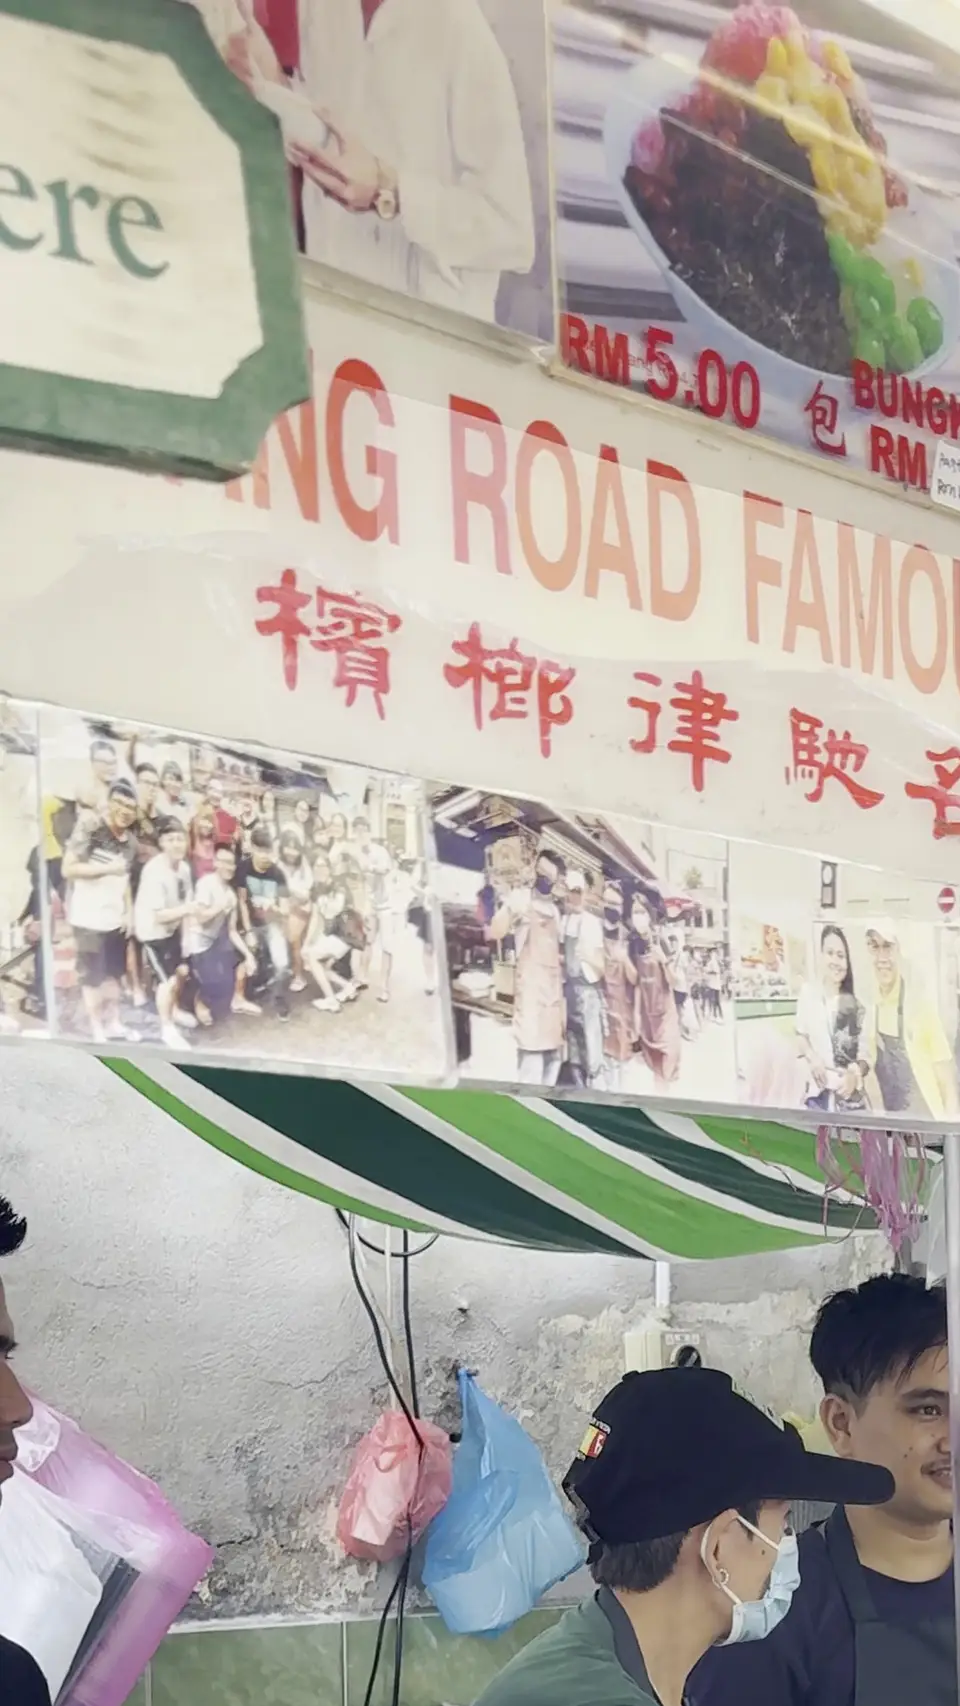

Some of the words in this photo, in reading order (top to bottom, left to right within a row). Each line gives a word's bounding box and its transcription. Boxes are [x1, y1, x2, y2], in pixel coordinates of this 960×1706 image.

[560, 313, 631, 386] RM
[645, 325, 760, 429] 5.00
[804, 379, 846, 456] 包
[871, 424, 928, 490] RM
[448, 393, 702, 621] ROAD
